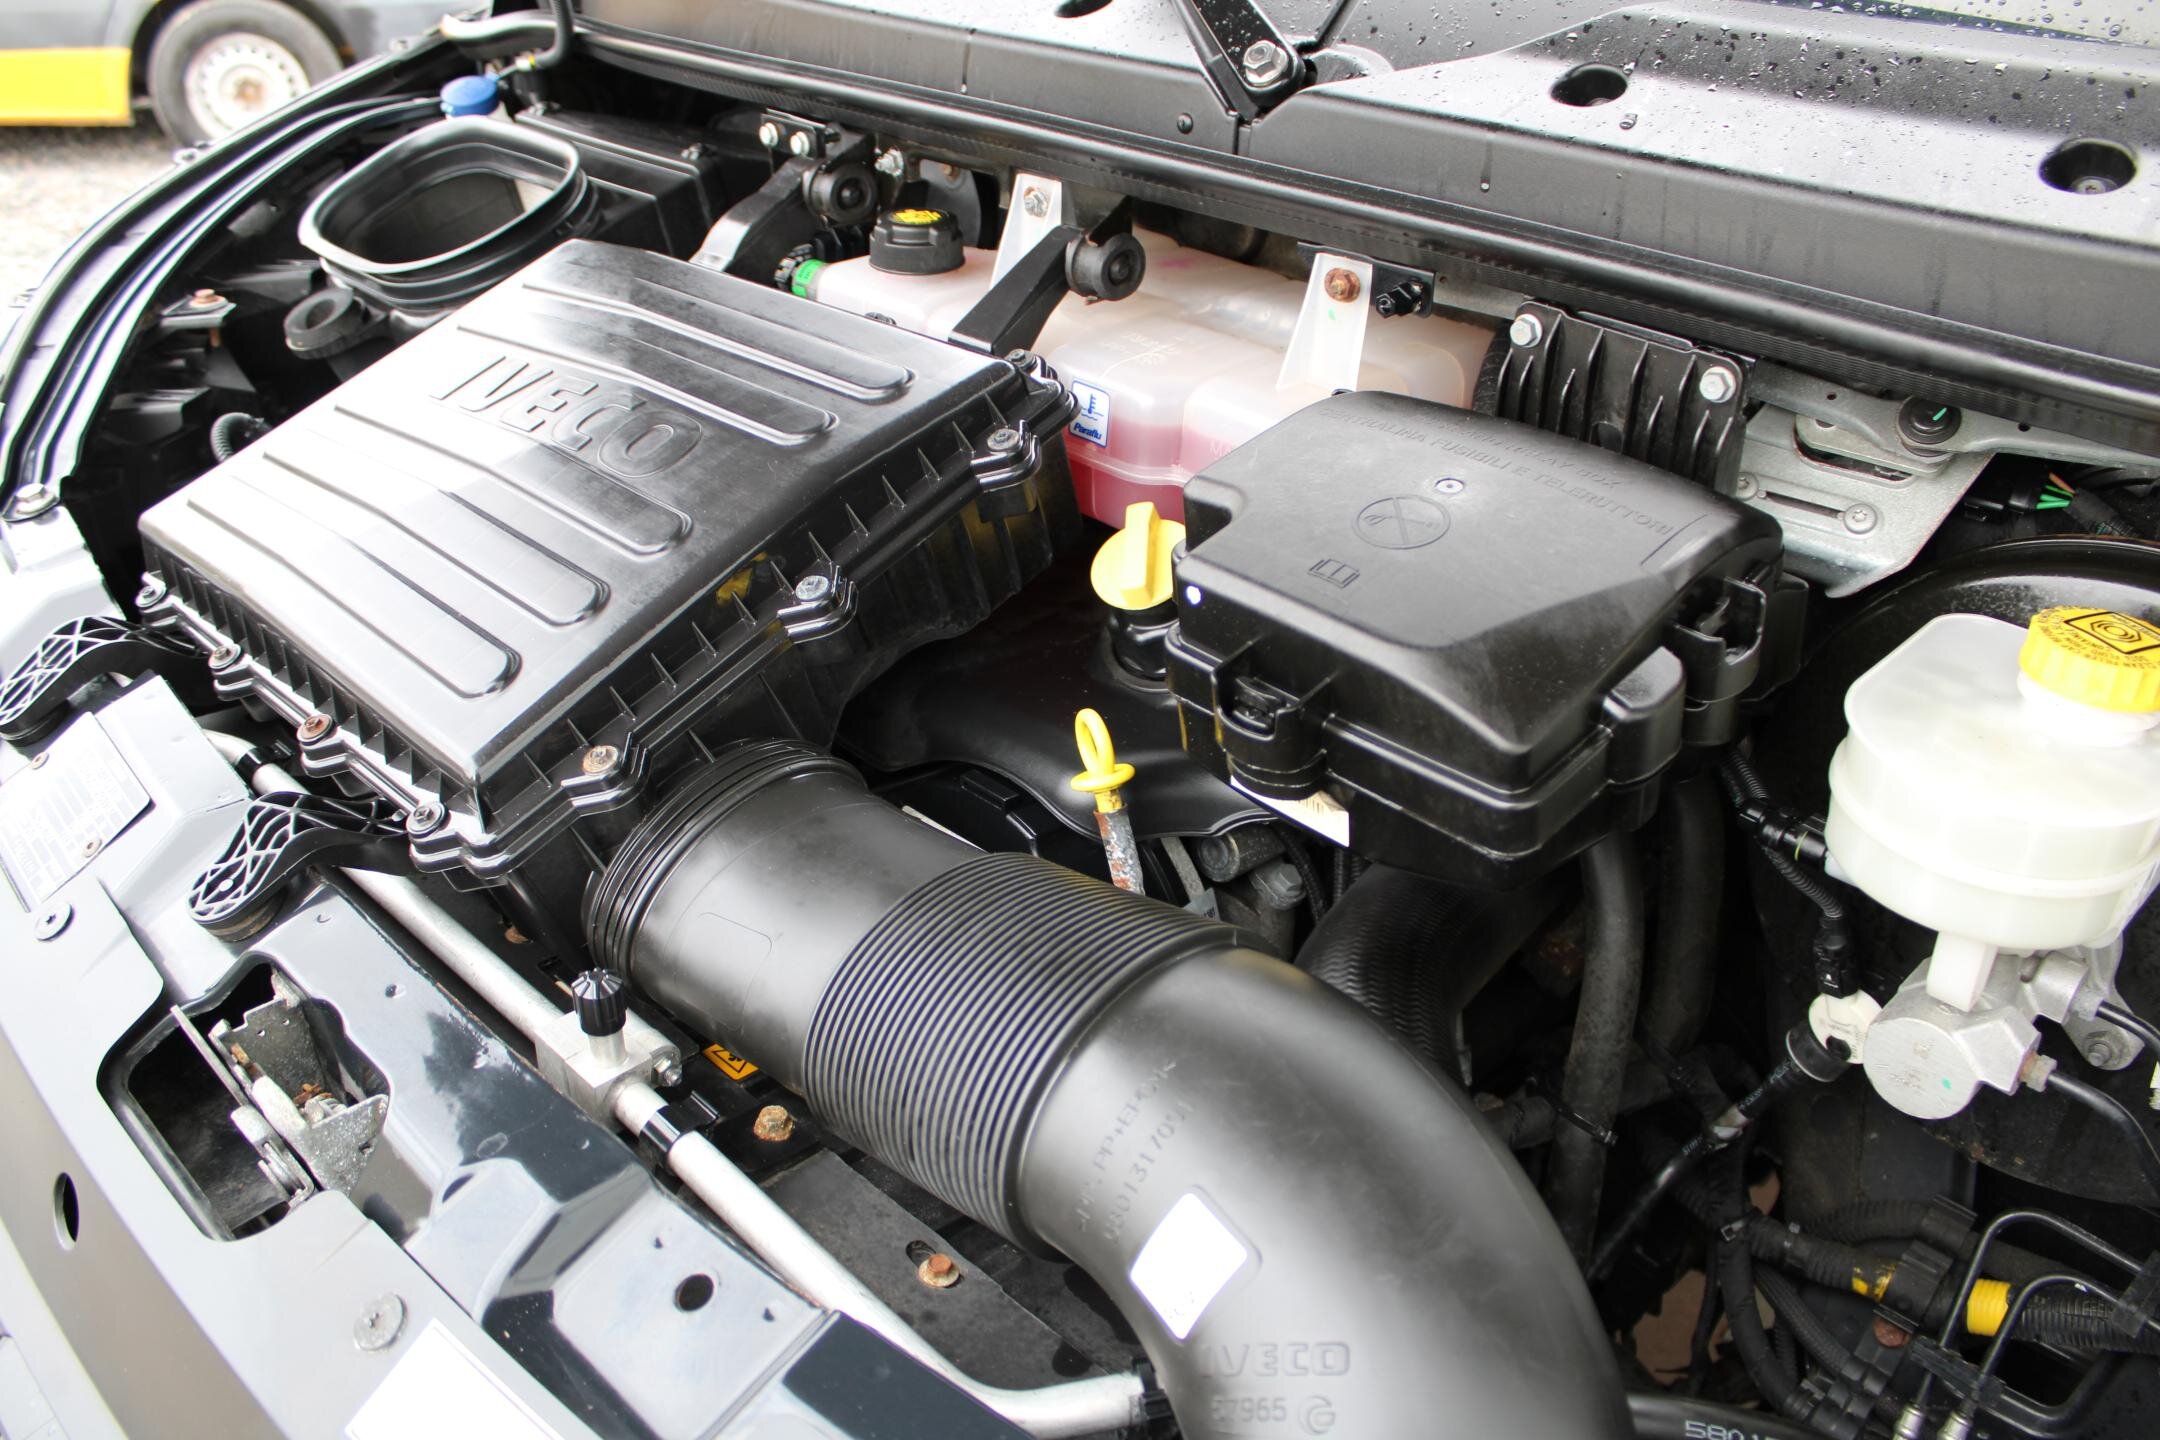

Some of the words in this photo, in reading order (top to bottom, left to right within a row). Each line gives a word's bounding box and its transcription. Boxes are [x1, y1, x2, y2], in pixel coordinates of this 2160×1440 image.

[431, 354, 704, 479] IVECO
[1073, 421, 1102, 440] Paraflu
[1200, 1341, 1351, 1379] IVECO
